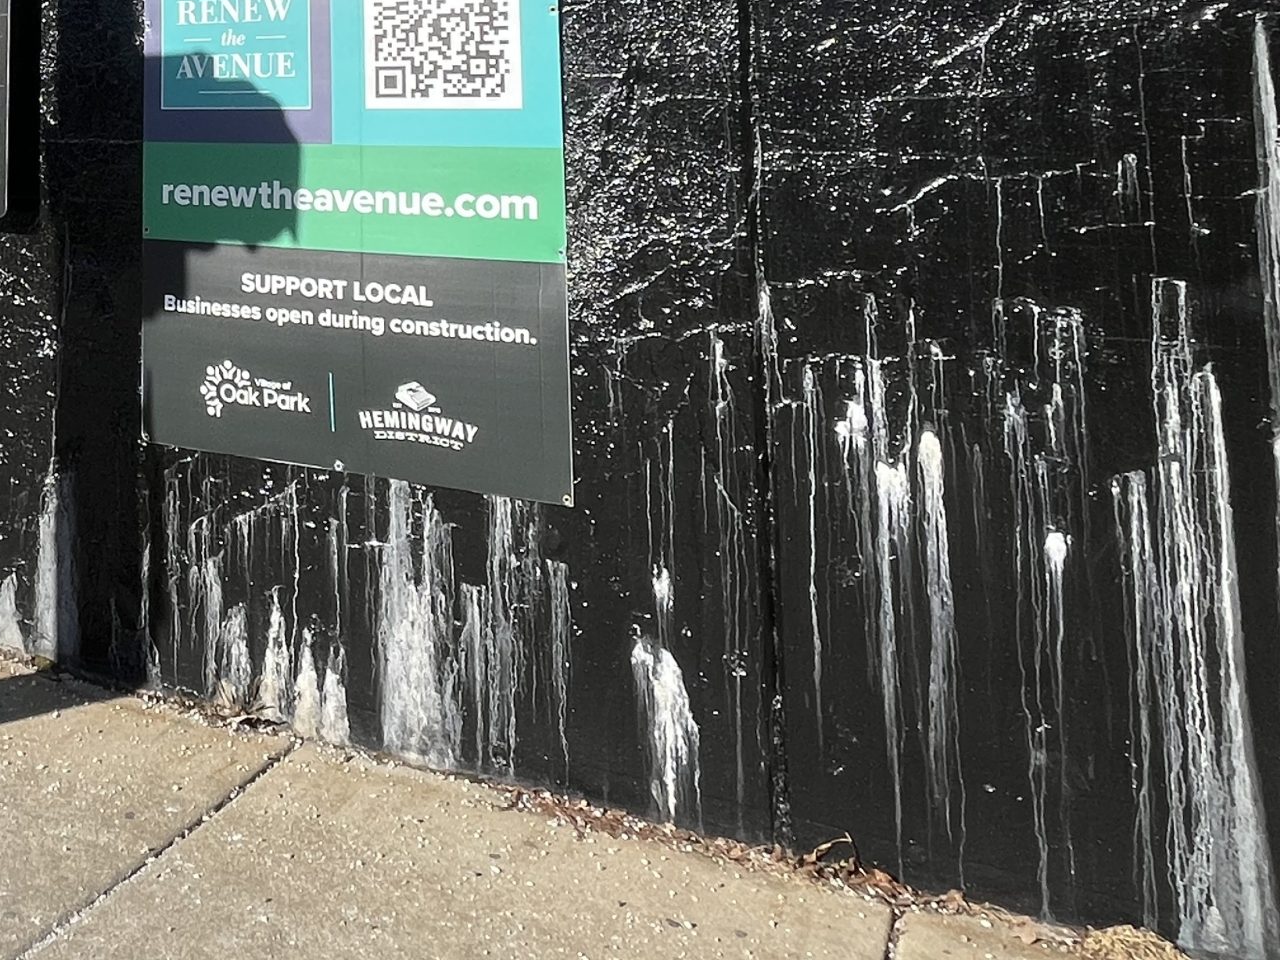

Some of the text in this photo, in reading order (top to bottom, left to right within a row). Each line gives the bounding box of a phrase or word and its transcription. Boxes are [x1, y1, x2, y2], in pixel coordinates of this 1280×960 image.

[220, 28, 246, 46] the
[175, 52, 294, 78] AVENUE
[161, 180, 537, 218] renewtheavenue.com
[240, 272, 432, 306] SUPPORT LOCAL
[163, 294, 537, 344] Businesses open during construction.
[220, 382, 310, 412] Oak Park
[358, 409, 478, 442] HEMINGWAY
[374, 430, 464, 450] DISTRICT
